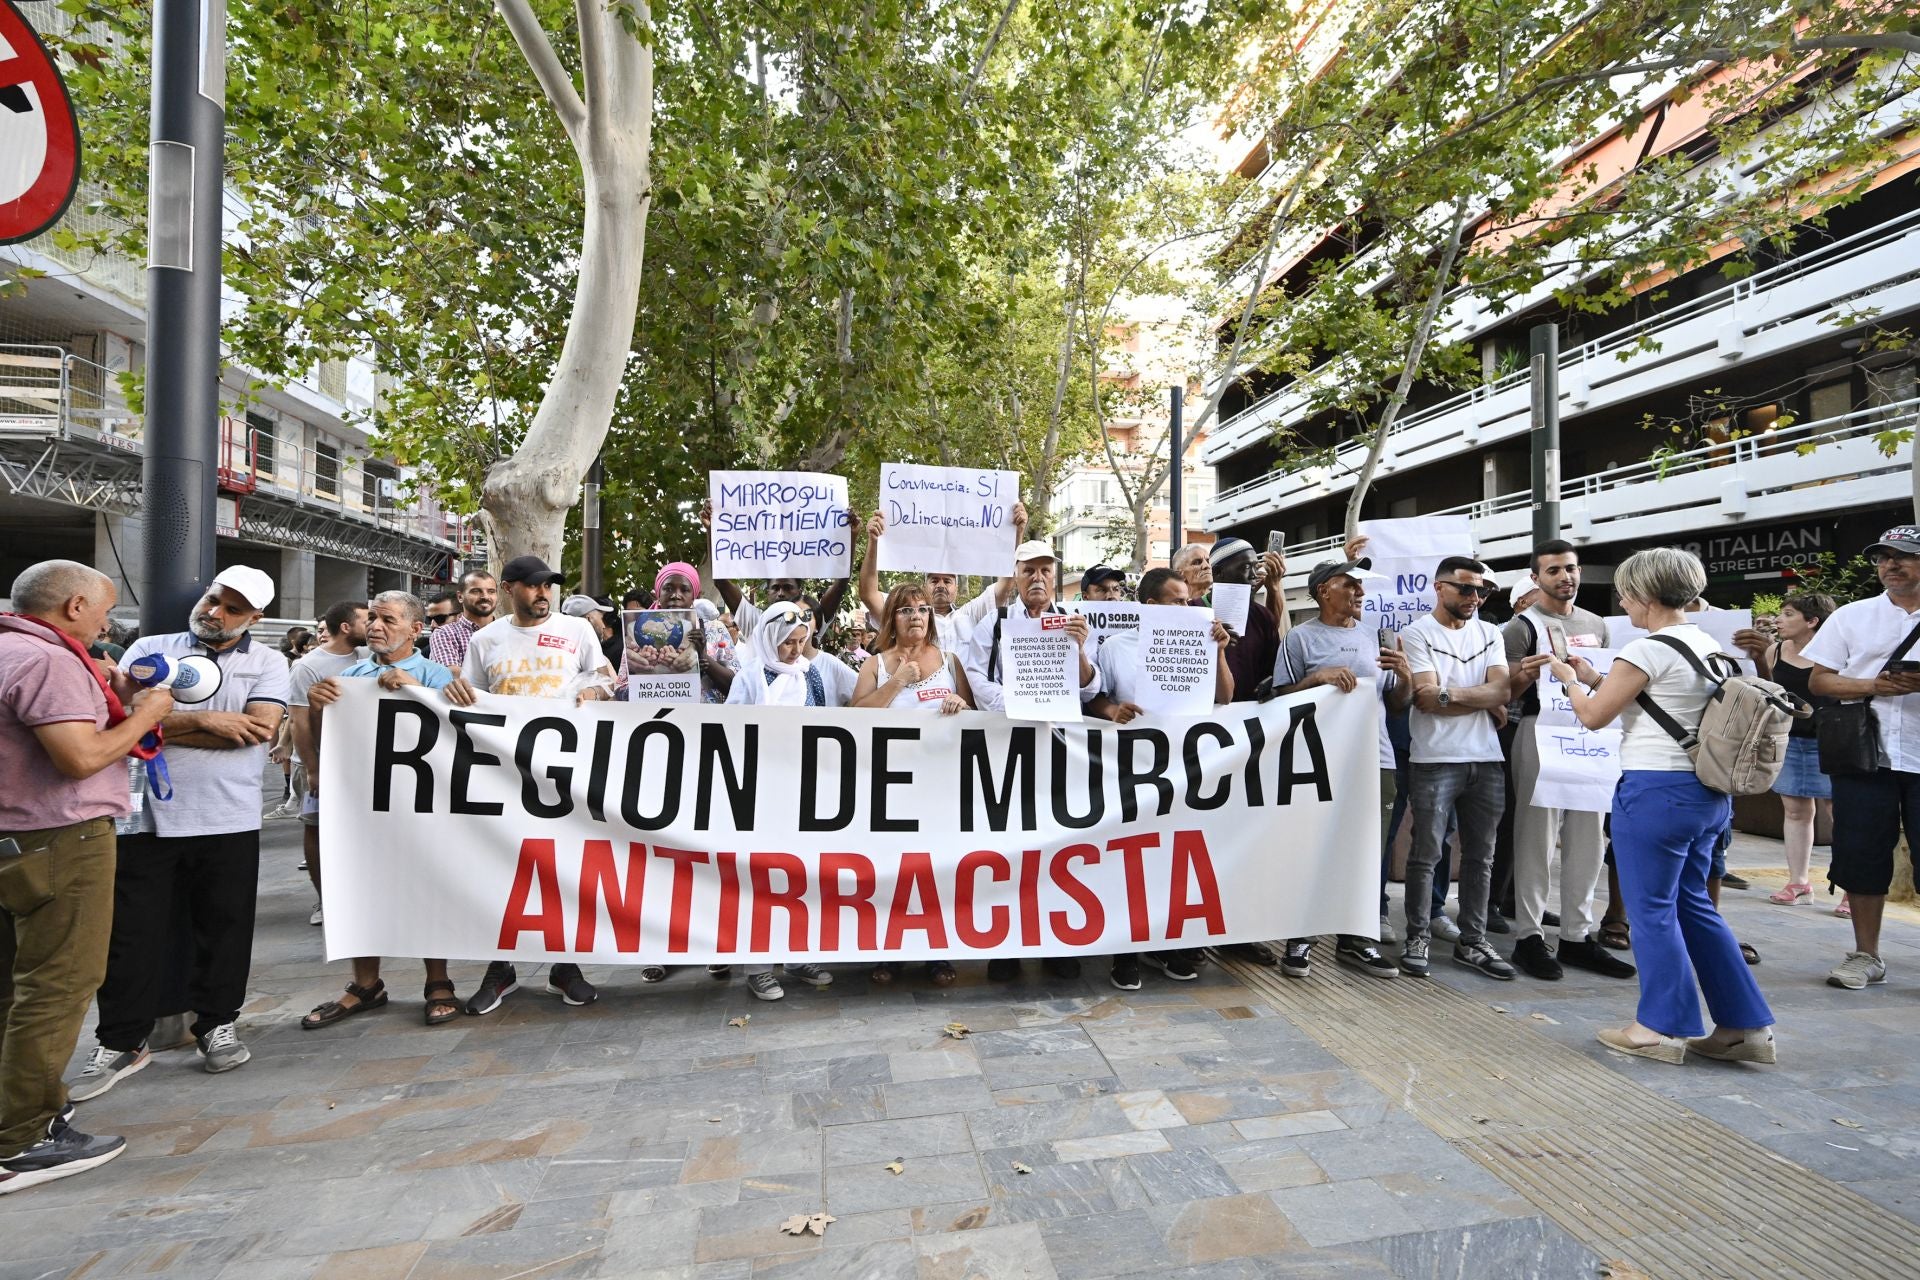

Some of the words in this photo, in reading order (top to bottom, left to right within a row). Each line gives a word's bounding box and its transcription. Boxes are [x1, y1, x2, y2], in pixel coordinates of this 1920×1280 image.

[100, 434, 134, 450] ATES
[716, 538, 846, 562] PACHEQUERO
[1708, 526, 1822, 558] ITALIAN
[1710, 557, 1766, 574] STREET
[1770, 552, 1820, 568] FOOD
[1396, 574, 1428, 595] NO
[1088, 612, 1106, 629] NO
[490, 656, 564, 676] MIAMI
[1158, 657, 1208, 665] OSCURIDAD
[372, 698, 758, 831] REGIÓN
[799, 726, 920, 832] DE
[960, 702, 1333, 832] MURCIA
[497, 830, 1226, 953] ANTIRRACISTA
